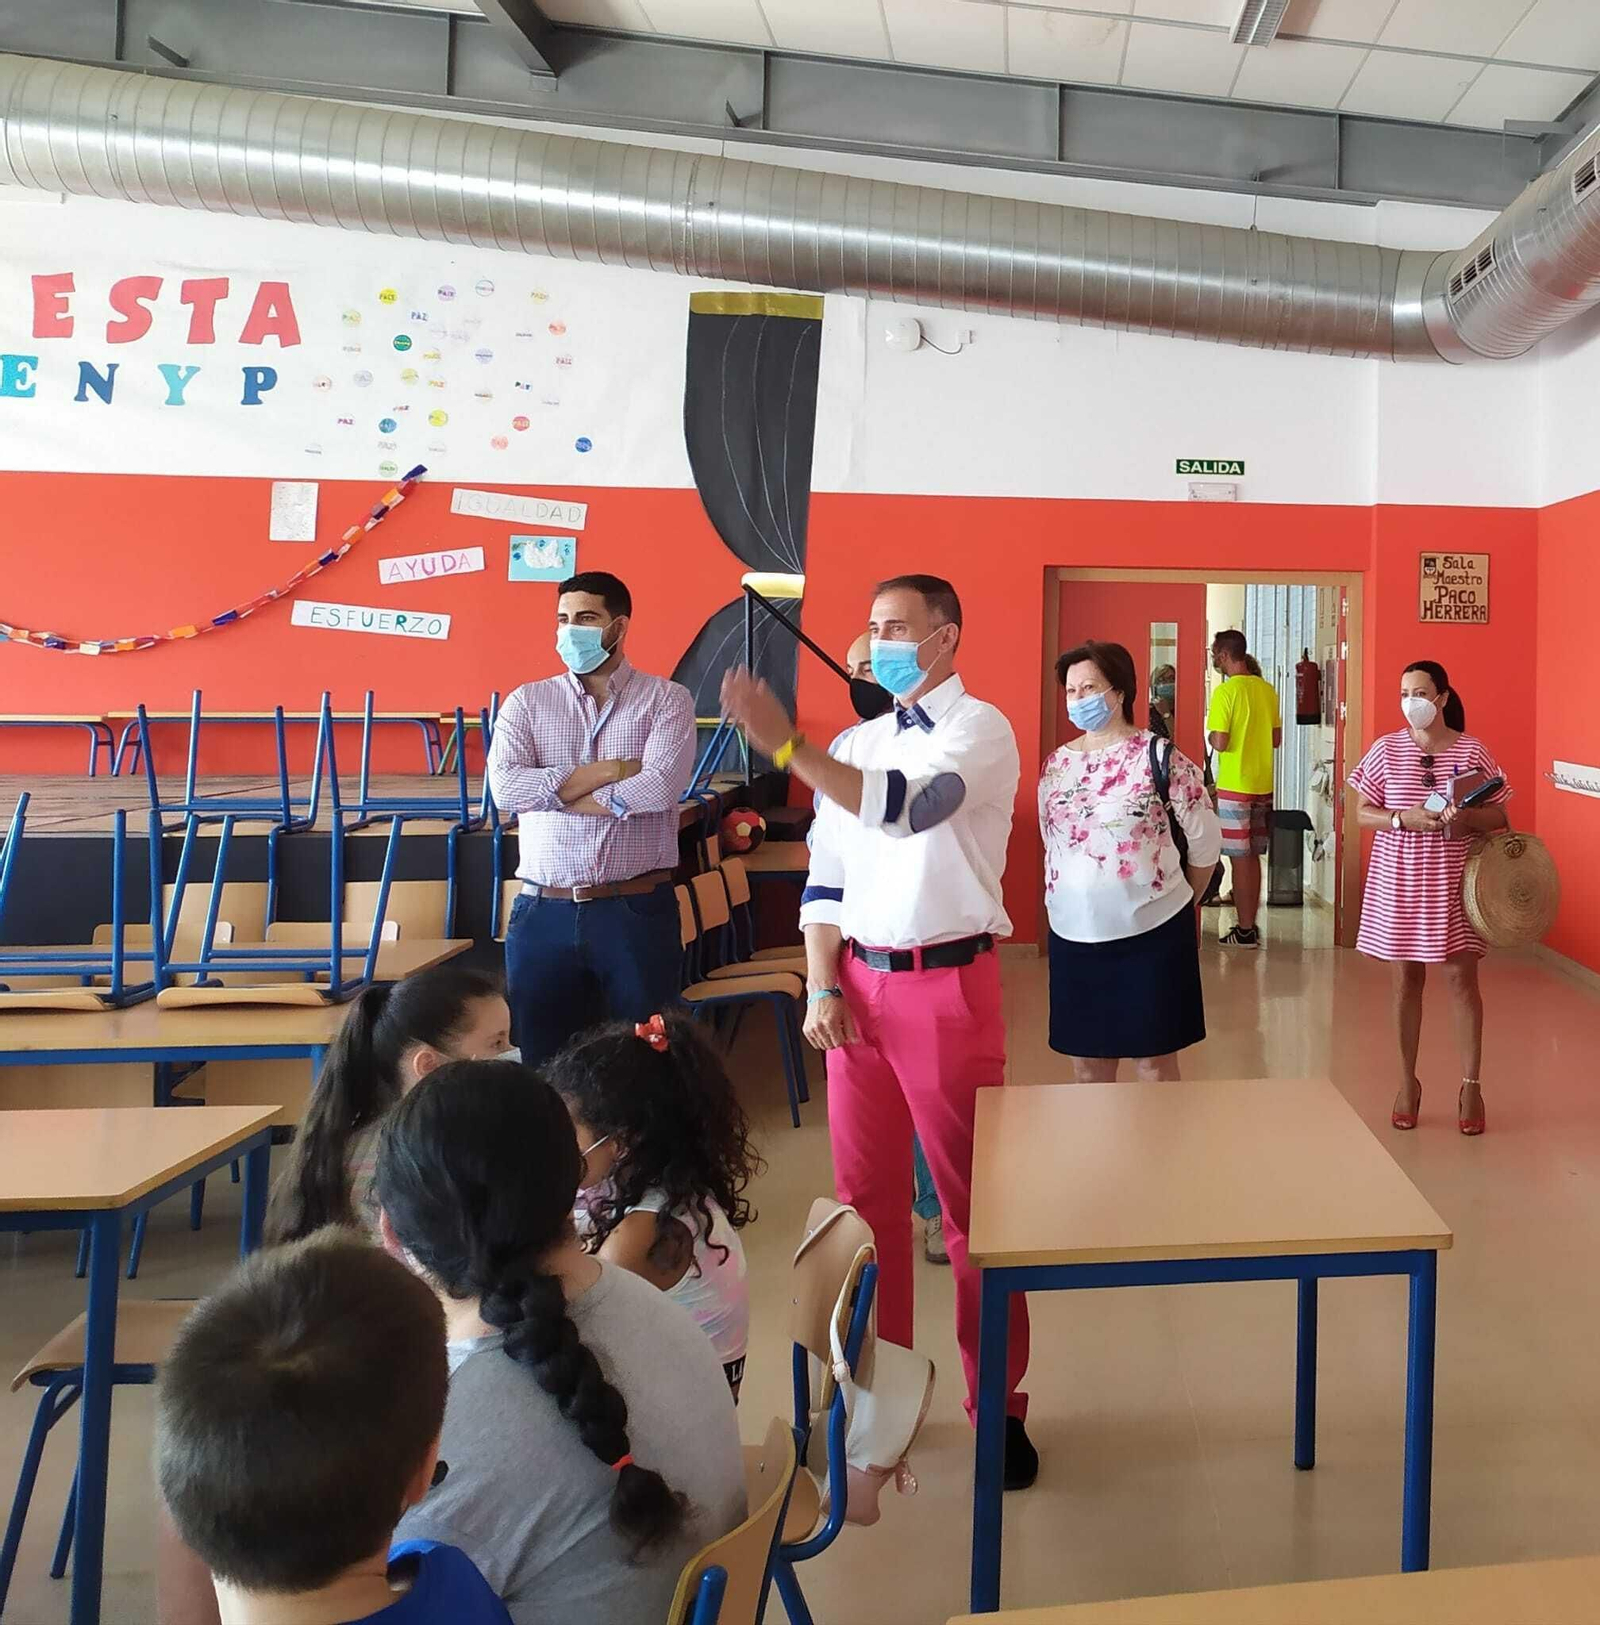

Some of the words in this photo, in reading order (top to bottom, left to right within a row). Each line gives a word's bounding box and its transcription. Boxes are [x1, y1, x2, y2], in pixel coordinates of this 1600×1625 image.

[31, 272, 301, 348] ESTA
[411, 311, 428, 321] PAZ
[1179, 460, 1241, 474] SALIDA
[455, 492, 582, 523] IGUALDAD
[388, 552, 471, 581] AYUDA
[1442, 556, 1475, 569] Sala
[1433, 570, 1483, 585] Maestro
[1433, 585, 1476, 604] PACO
[1421, 600, 1487, 621] HERRERA
[310, 606, 443, 636] ESFUERZO
